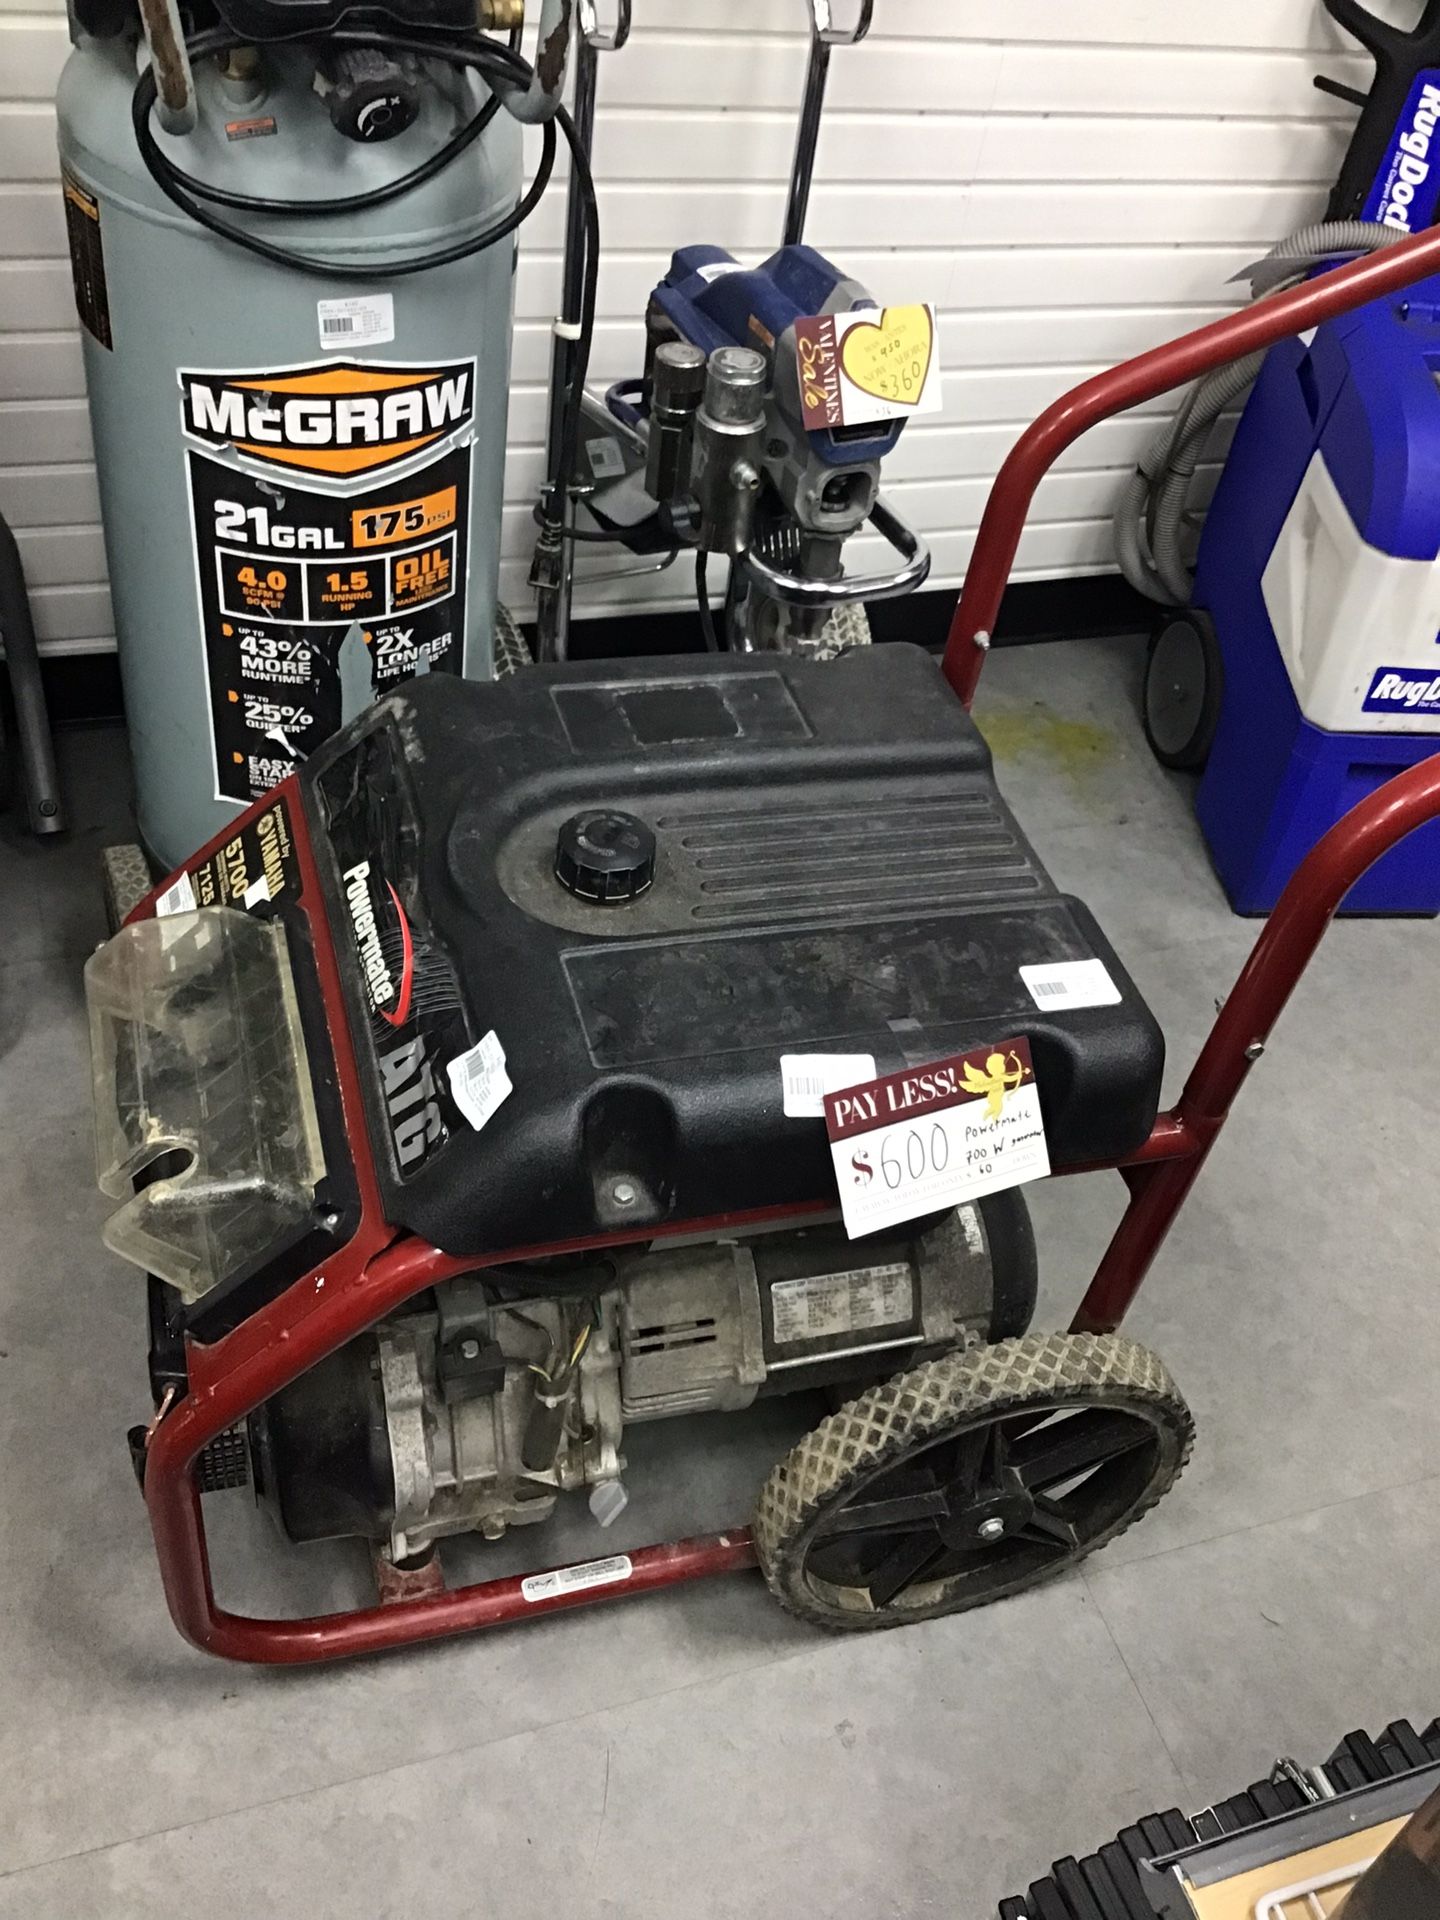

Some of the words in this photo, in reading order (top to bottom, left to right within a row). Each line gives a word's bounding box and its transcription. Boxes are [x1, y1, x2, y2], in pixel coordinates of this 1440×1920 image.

[799, 337, 829, 410] Sale
[191, 372, 468, 444] McGRAW
[396, 549, 449, 580] OIL
[237, 567, 287, 591] 4.0
[326, 571, 368, 592] 1.5
[396, 564, 449, 594] FREE
[321, 591, 373, 602] RUNNING
[340, 603, 355, 611] HP
[238, 627, 251, 635] UP
[376, 628, 414, 656] 2X
[240, 636, 311, 660] 43%
[377, 632, 452, 670] LONGER
[241, 655, 312, 675] MORE
[377, 666, 400, 679] LIFE
[243, 693, 256, 701] UP
[244, 701, 314, 725] 25%
[248, 755, 295, 772] EASY
[272, 804, 289, 845] powered
[281, 843, 290, 858] by
[226, 836, 249, 899] 5700
[260, 828, 285, 900] YAMAHA
[199, 862, 215, 906] 7125
[343, 860, 394, 1005] Powermate
[834, 1089, 879, 1127] PAY
[886, 1068, 958, 1112] LESS!
[965, 1148, 987, 1165] 700
[993, 1136, 1005, 1155] W
